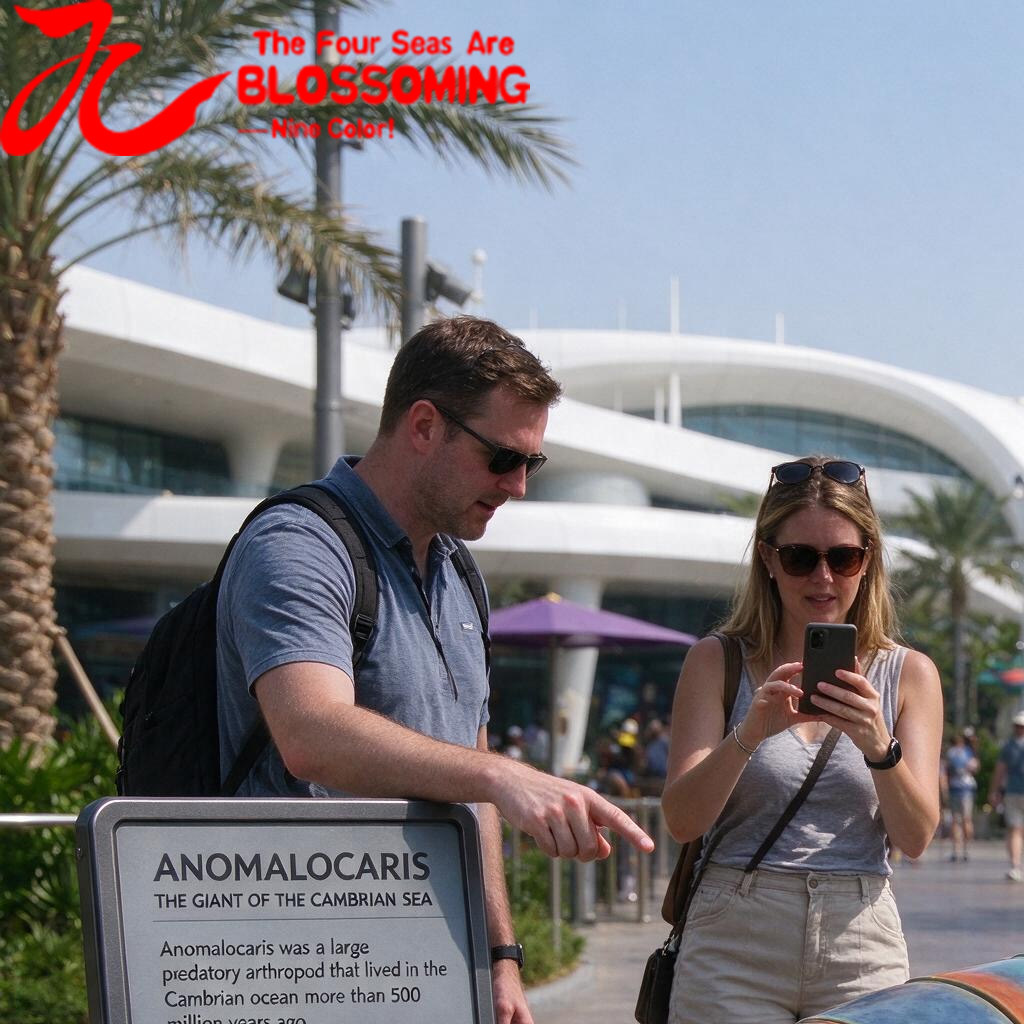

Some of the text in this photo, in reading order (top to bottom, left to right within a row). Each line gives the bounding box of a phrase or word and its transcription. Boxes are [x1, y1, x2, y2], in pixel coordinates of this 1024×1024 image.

[153, 852, 430, 881] ANOMALOCARIS
[154, 892, 433, 908] THE GIANT OF THE CAMBRIAN SEA
[160, 938, 369, 959] Anomalocaris was a large
[162, 960, 448, 986] predatory arthropod that lived in the
[164, 986, 421, 1008] Cambrian ocean more than 500
